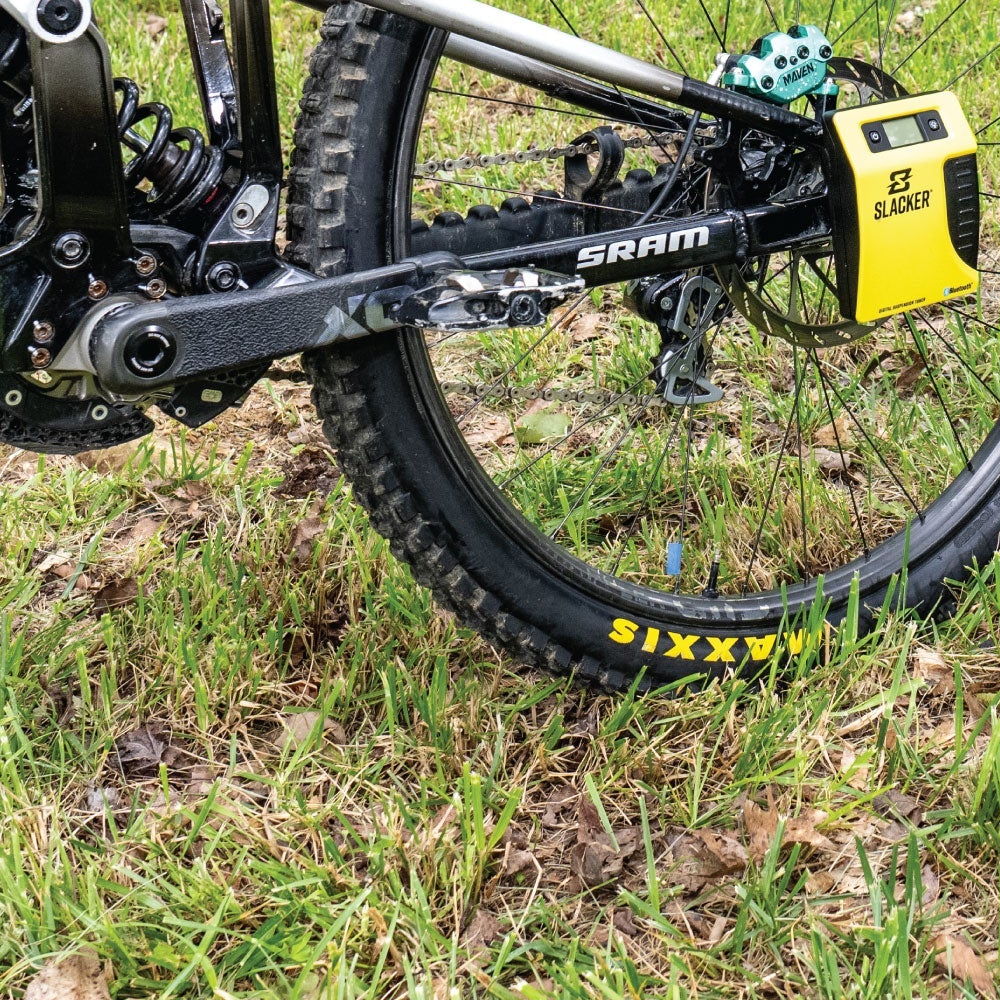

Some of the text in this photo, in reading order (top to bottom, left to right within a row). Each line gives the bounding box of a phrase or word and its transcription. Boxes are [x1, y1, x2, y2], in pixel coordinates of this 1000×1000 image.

[782, 62, 815, 87] MAVEN
[874, 190, 930, 221] SLACKER
[576, 226, 710, 269] SRAM
